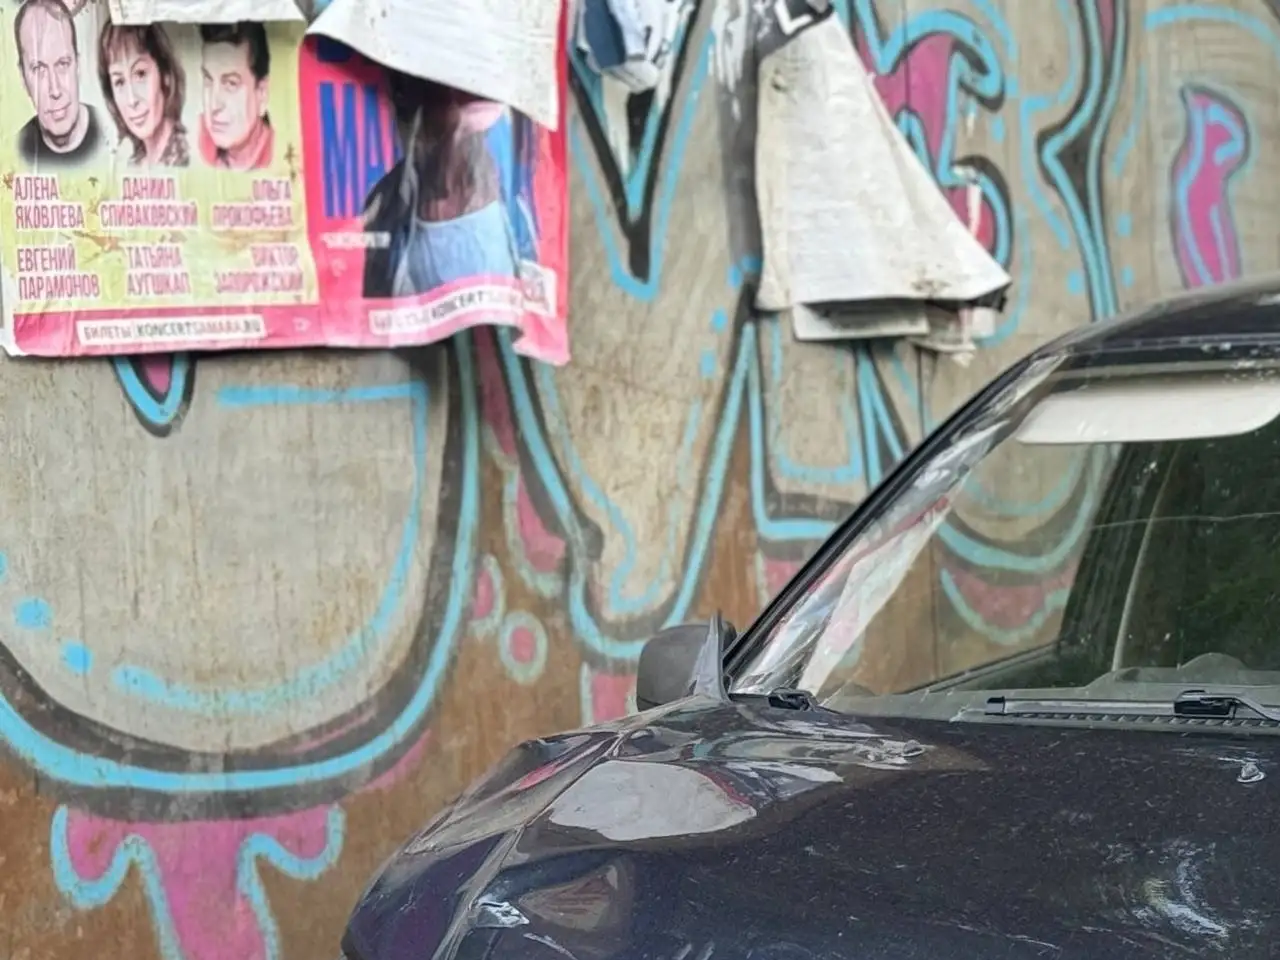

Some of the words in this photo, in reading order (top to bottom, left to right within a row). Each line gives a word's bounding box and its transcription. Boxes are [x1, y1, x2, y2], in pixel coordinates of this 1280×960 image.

[14, 176, 59, 200] АЛЕНА
[122, 177, 176, 201] ДАНИИЛ
[15, 204, 85, 229] ЯКОВЛЕВА
[17, 243, 76, 272] ЕВГЕНИЙ
[18, 274, 100, 300] ПАРАМОНОВ
[83, 325, 132, 341] БИЛЕТЫ
